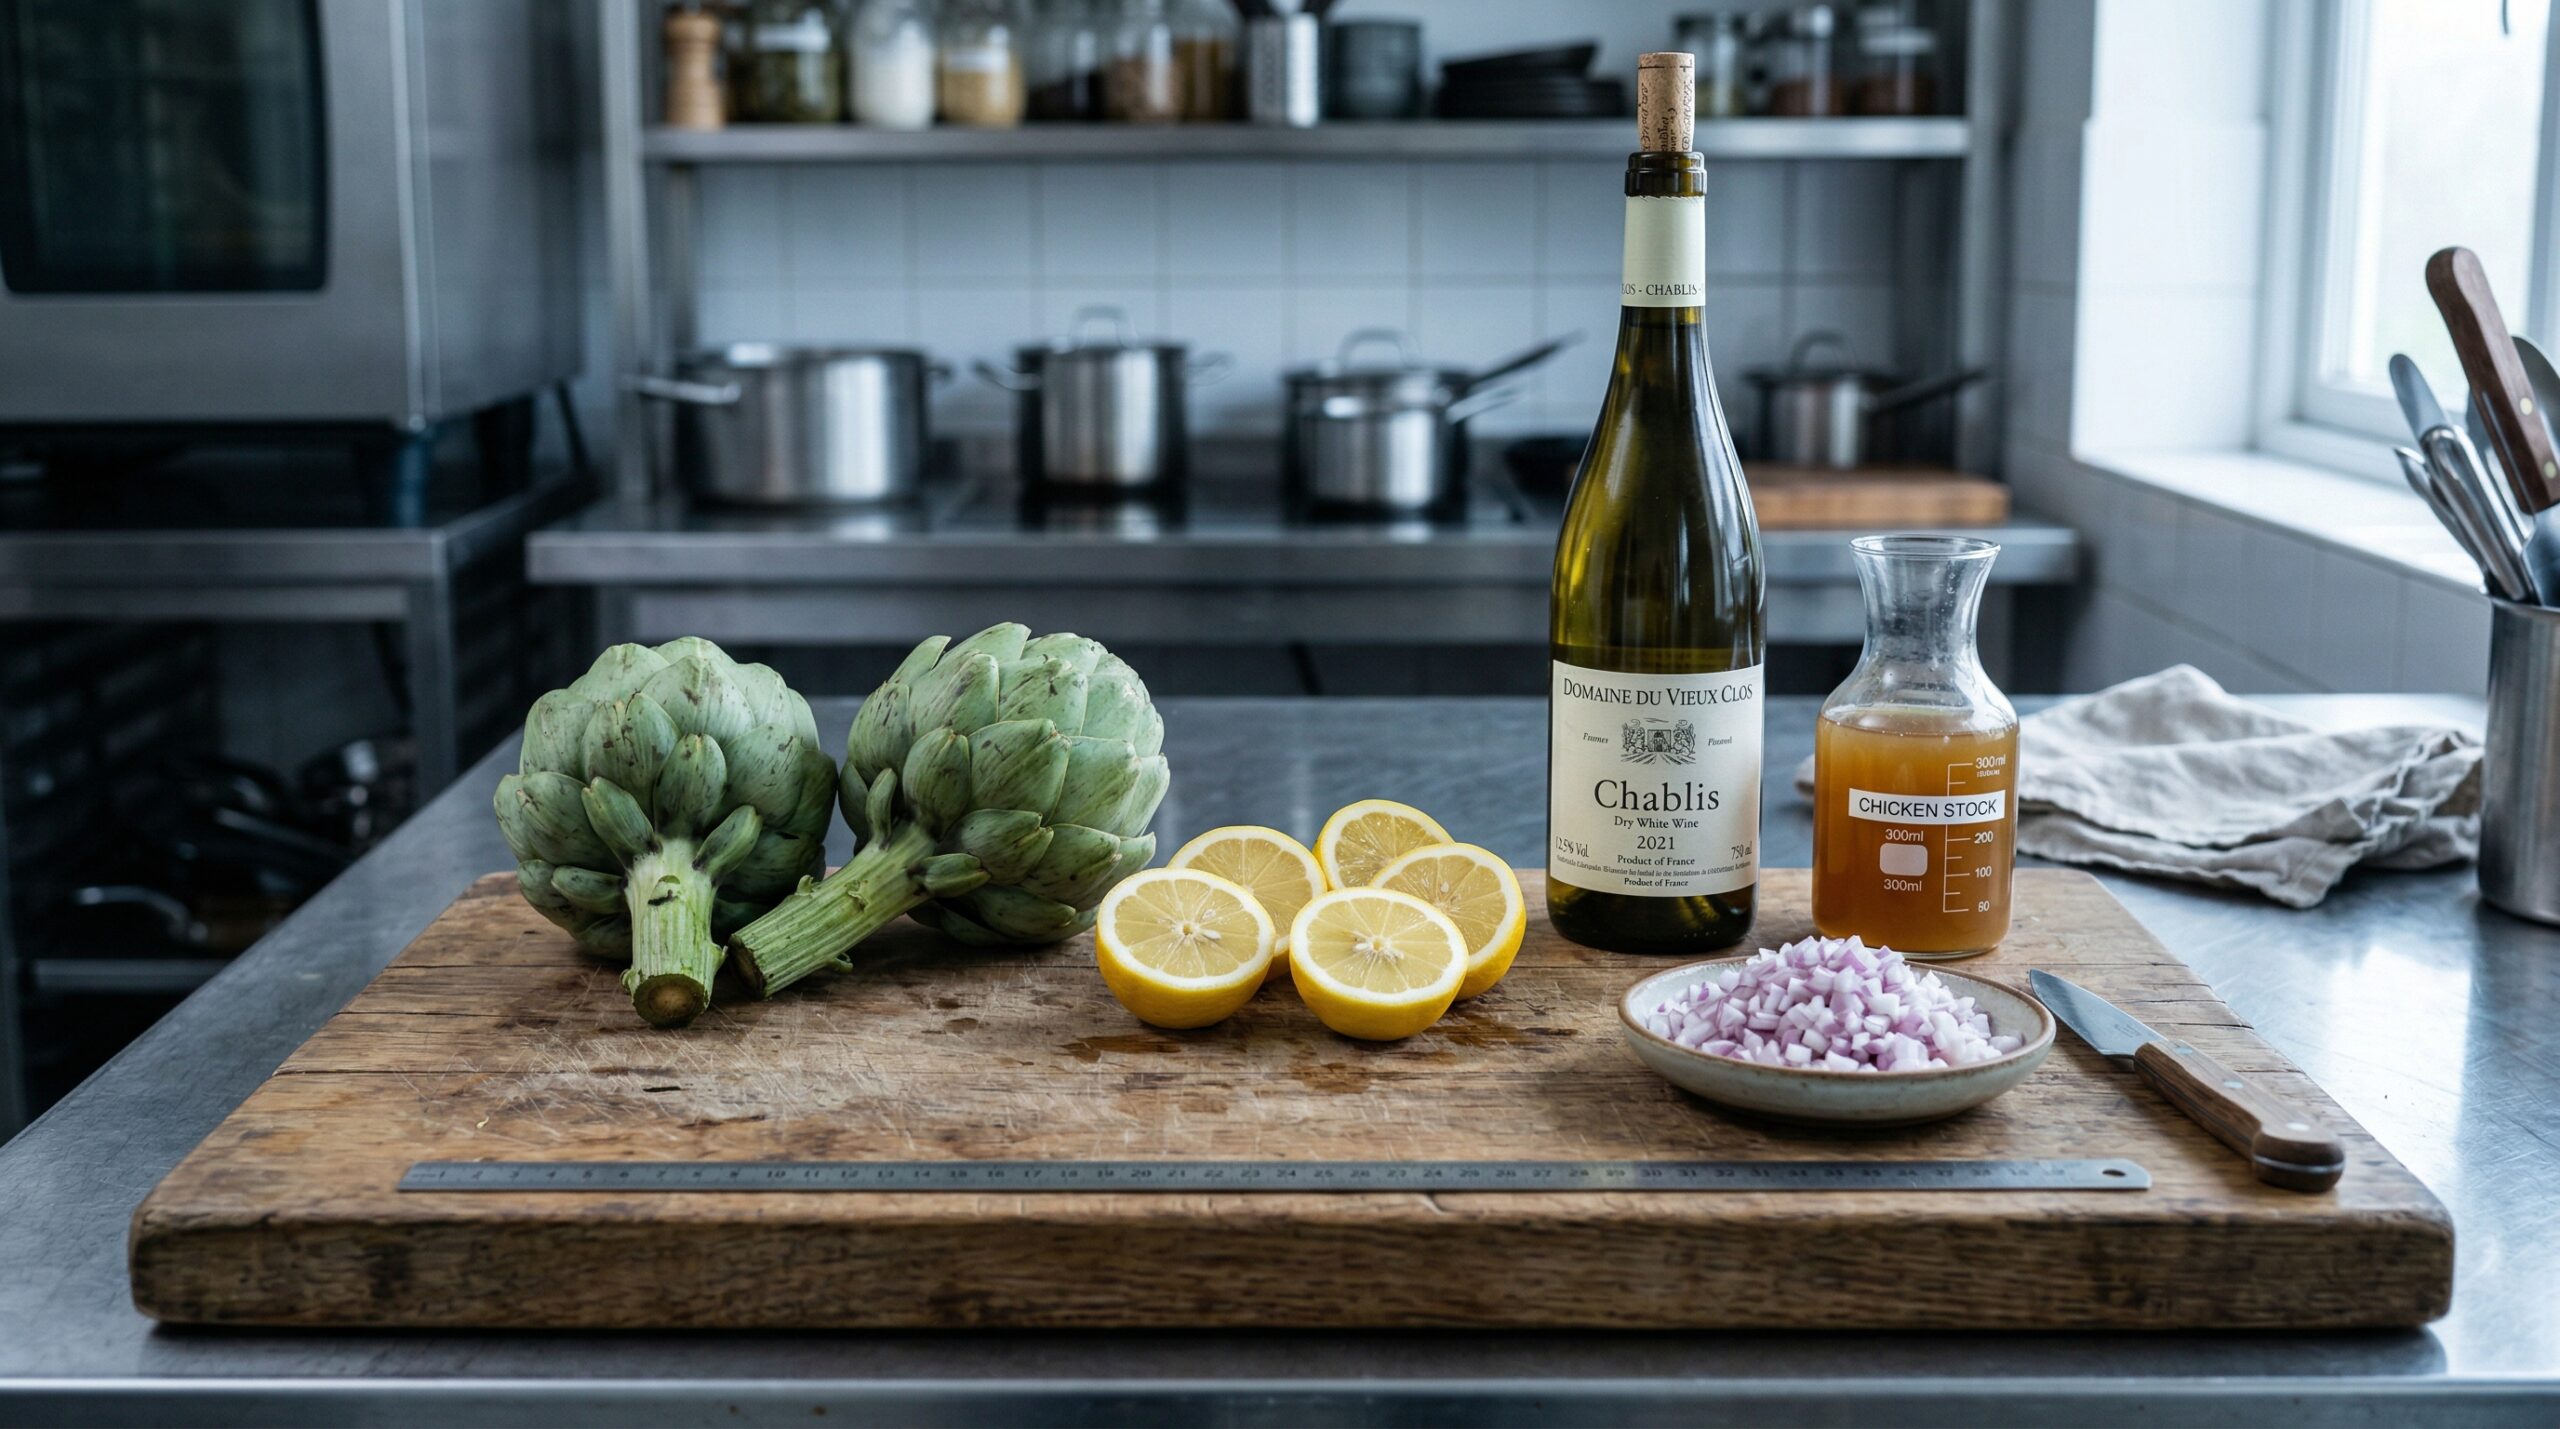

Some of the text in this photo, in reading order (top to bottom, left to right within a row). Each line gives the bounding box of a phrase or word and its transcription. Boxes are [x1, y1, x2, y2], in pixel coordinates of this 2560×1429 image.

[1645, 284, 1698, 296] CHABLIS
[1563, 677, 1753, 706] DOMAINE DU VIEUX CLOS
[1975, 754, 2006, 769] 300ml
[1594, 779, 1720, 812] Chablis
[1859, 797, 1997, 818] CHICKEN STOCK
[1614, 815, 1699, 830] Dry White Wine
[1885, 828, 1924, 842] 300ml
[1974, 830, 1994, 844] 200
[1636, 835, 1675, 850] 2021
[1617, 854, 1651, 866] Product
[1654, 857, 1665, 866] of
[1666, 857, 1696, 866] France
[1975, 865, 1992, 879] 100
[1624, 877, 1689, 887] Product of France
[1883, 878, 1922, 892] 300ml
